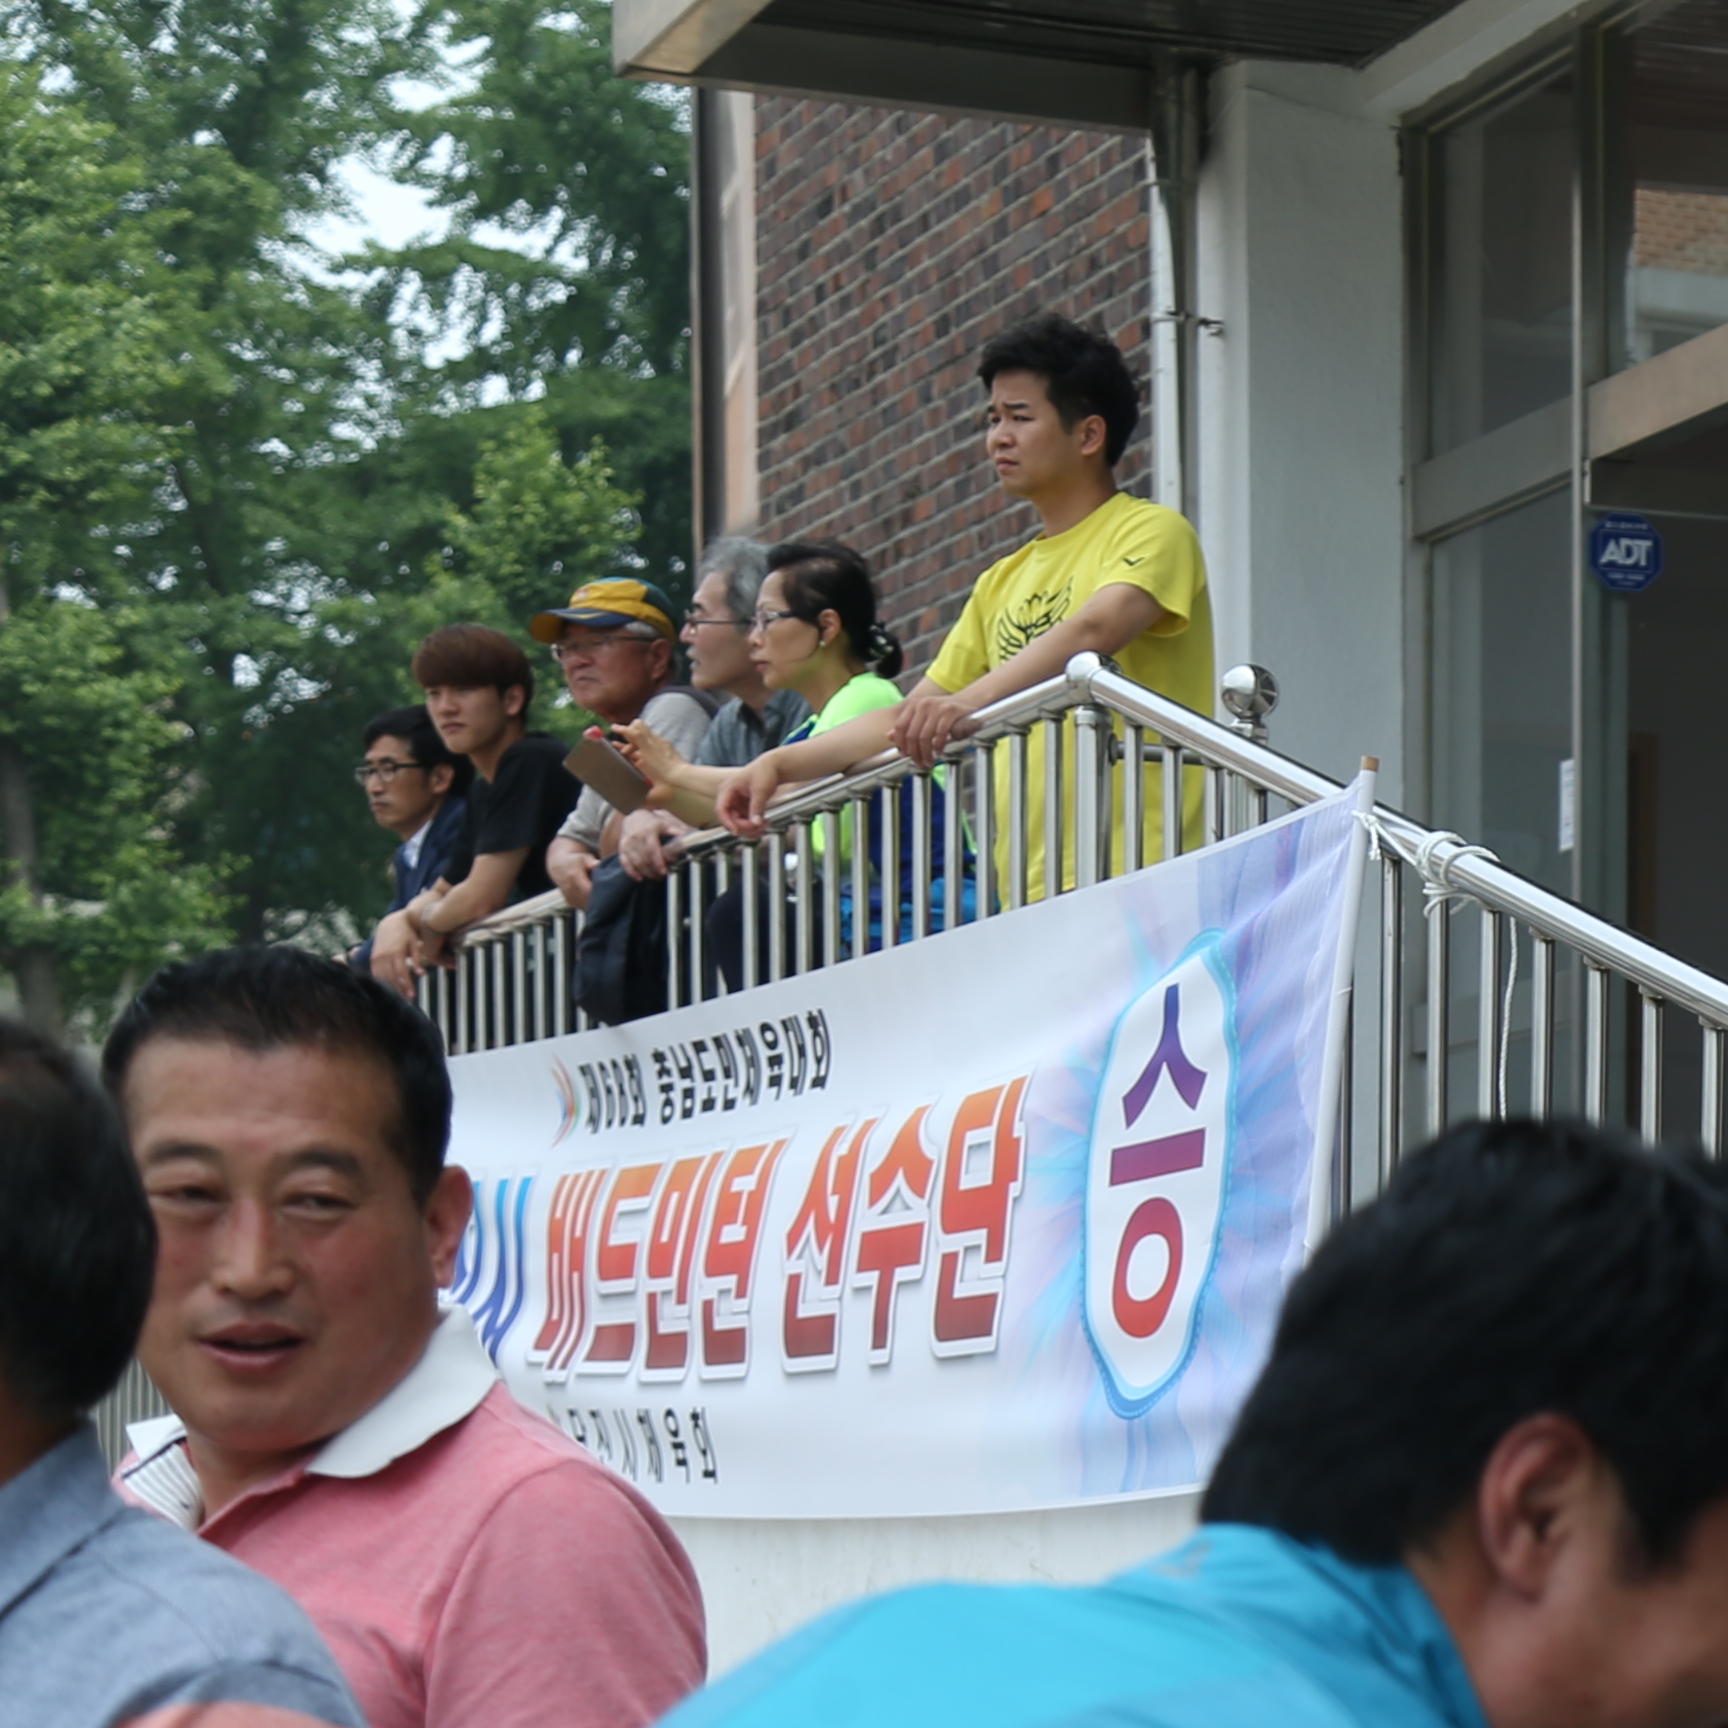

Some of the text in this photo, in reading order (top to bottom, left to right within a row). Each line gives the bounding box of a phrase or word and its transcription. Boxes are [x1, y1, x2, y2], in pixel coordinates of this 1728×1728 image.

[1599, 537, 1654, 567] ADT
[652, 1008, 831, 1125] 충남도민체육대회
[1108, 982, 1208, 1339] 승
[531, 1137, 789, 1372] 배드민턴
[783, 1074, 1029, 1359] 선수단
